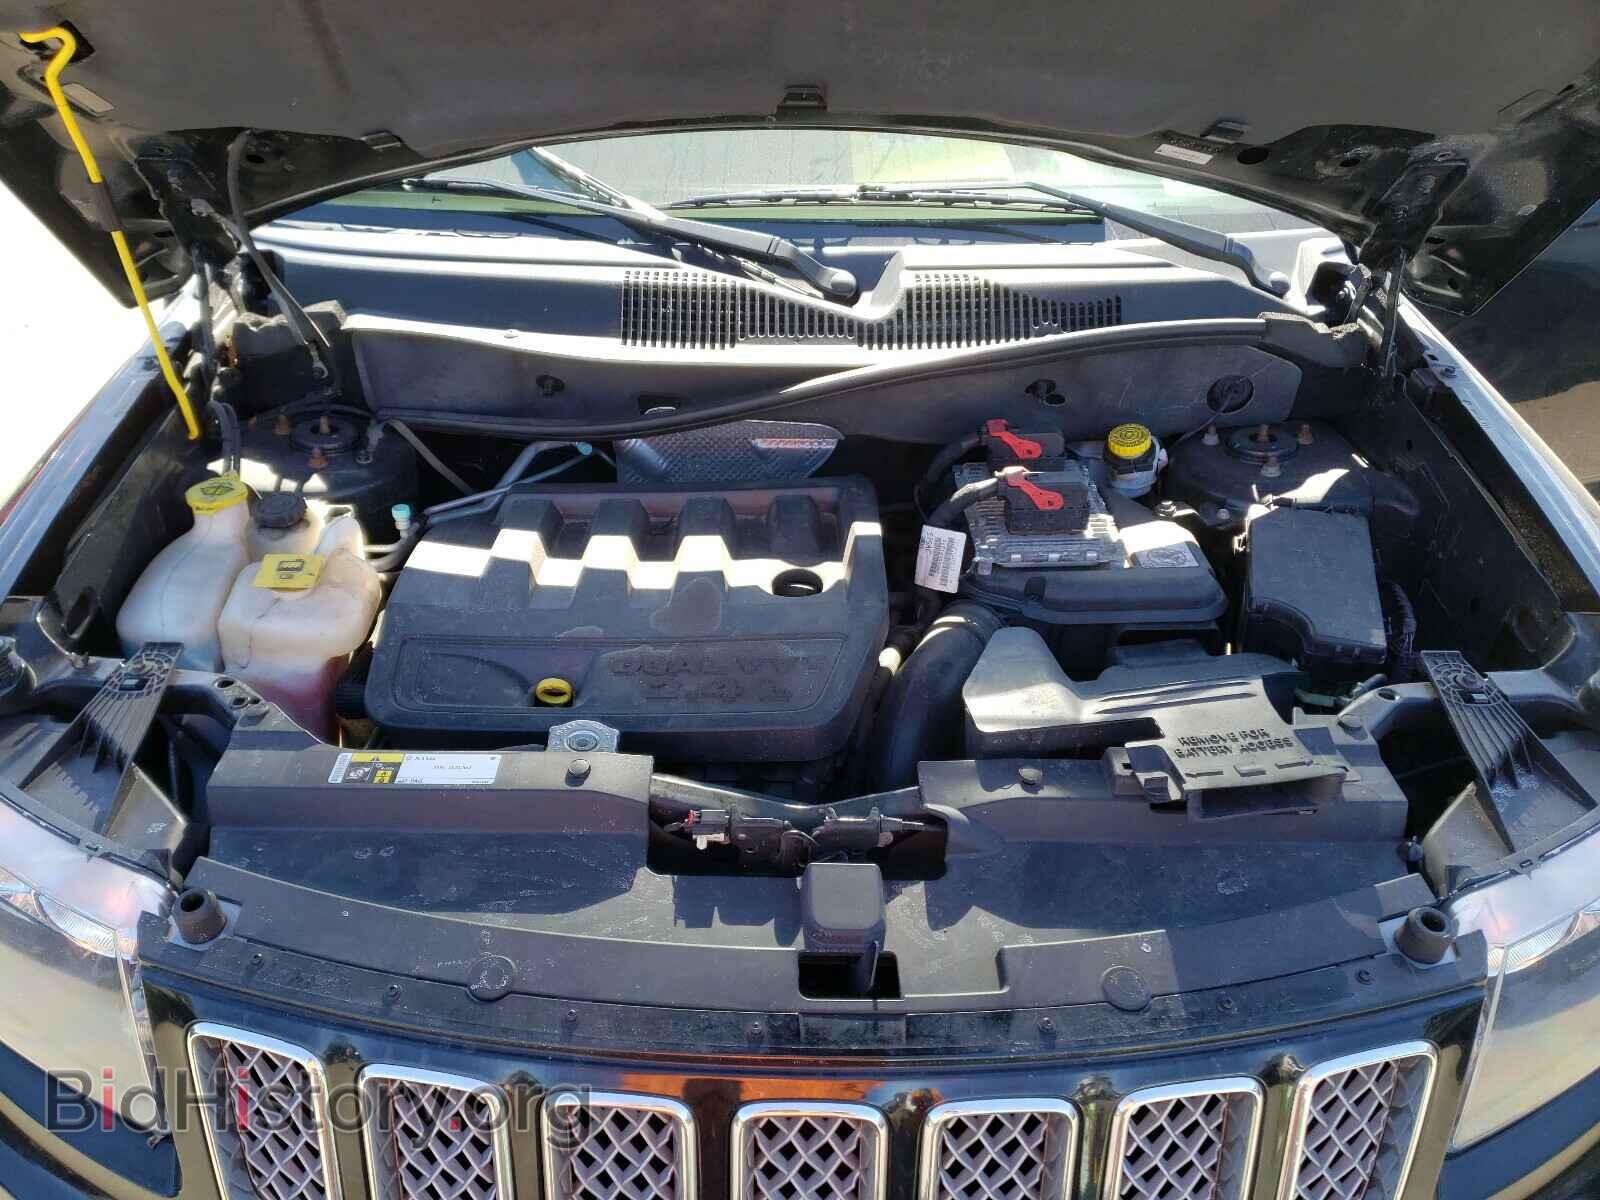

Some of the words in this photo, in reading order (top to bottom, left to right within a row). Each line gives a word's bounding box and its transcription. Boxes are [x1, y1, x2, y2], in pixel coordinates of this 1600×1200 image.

[1177, 733, 1239, 747] REMOVE
[1239, 728, 1271, 741] FOR
[1174, 744, 1233, 759] BATTERY
[1239, 737, 1294, 754] ACCESS
